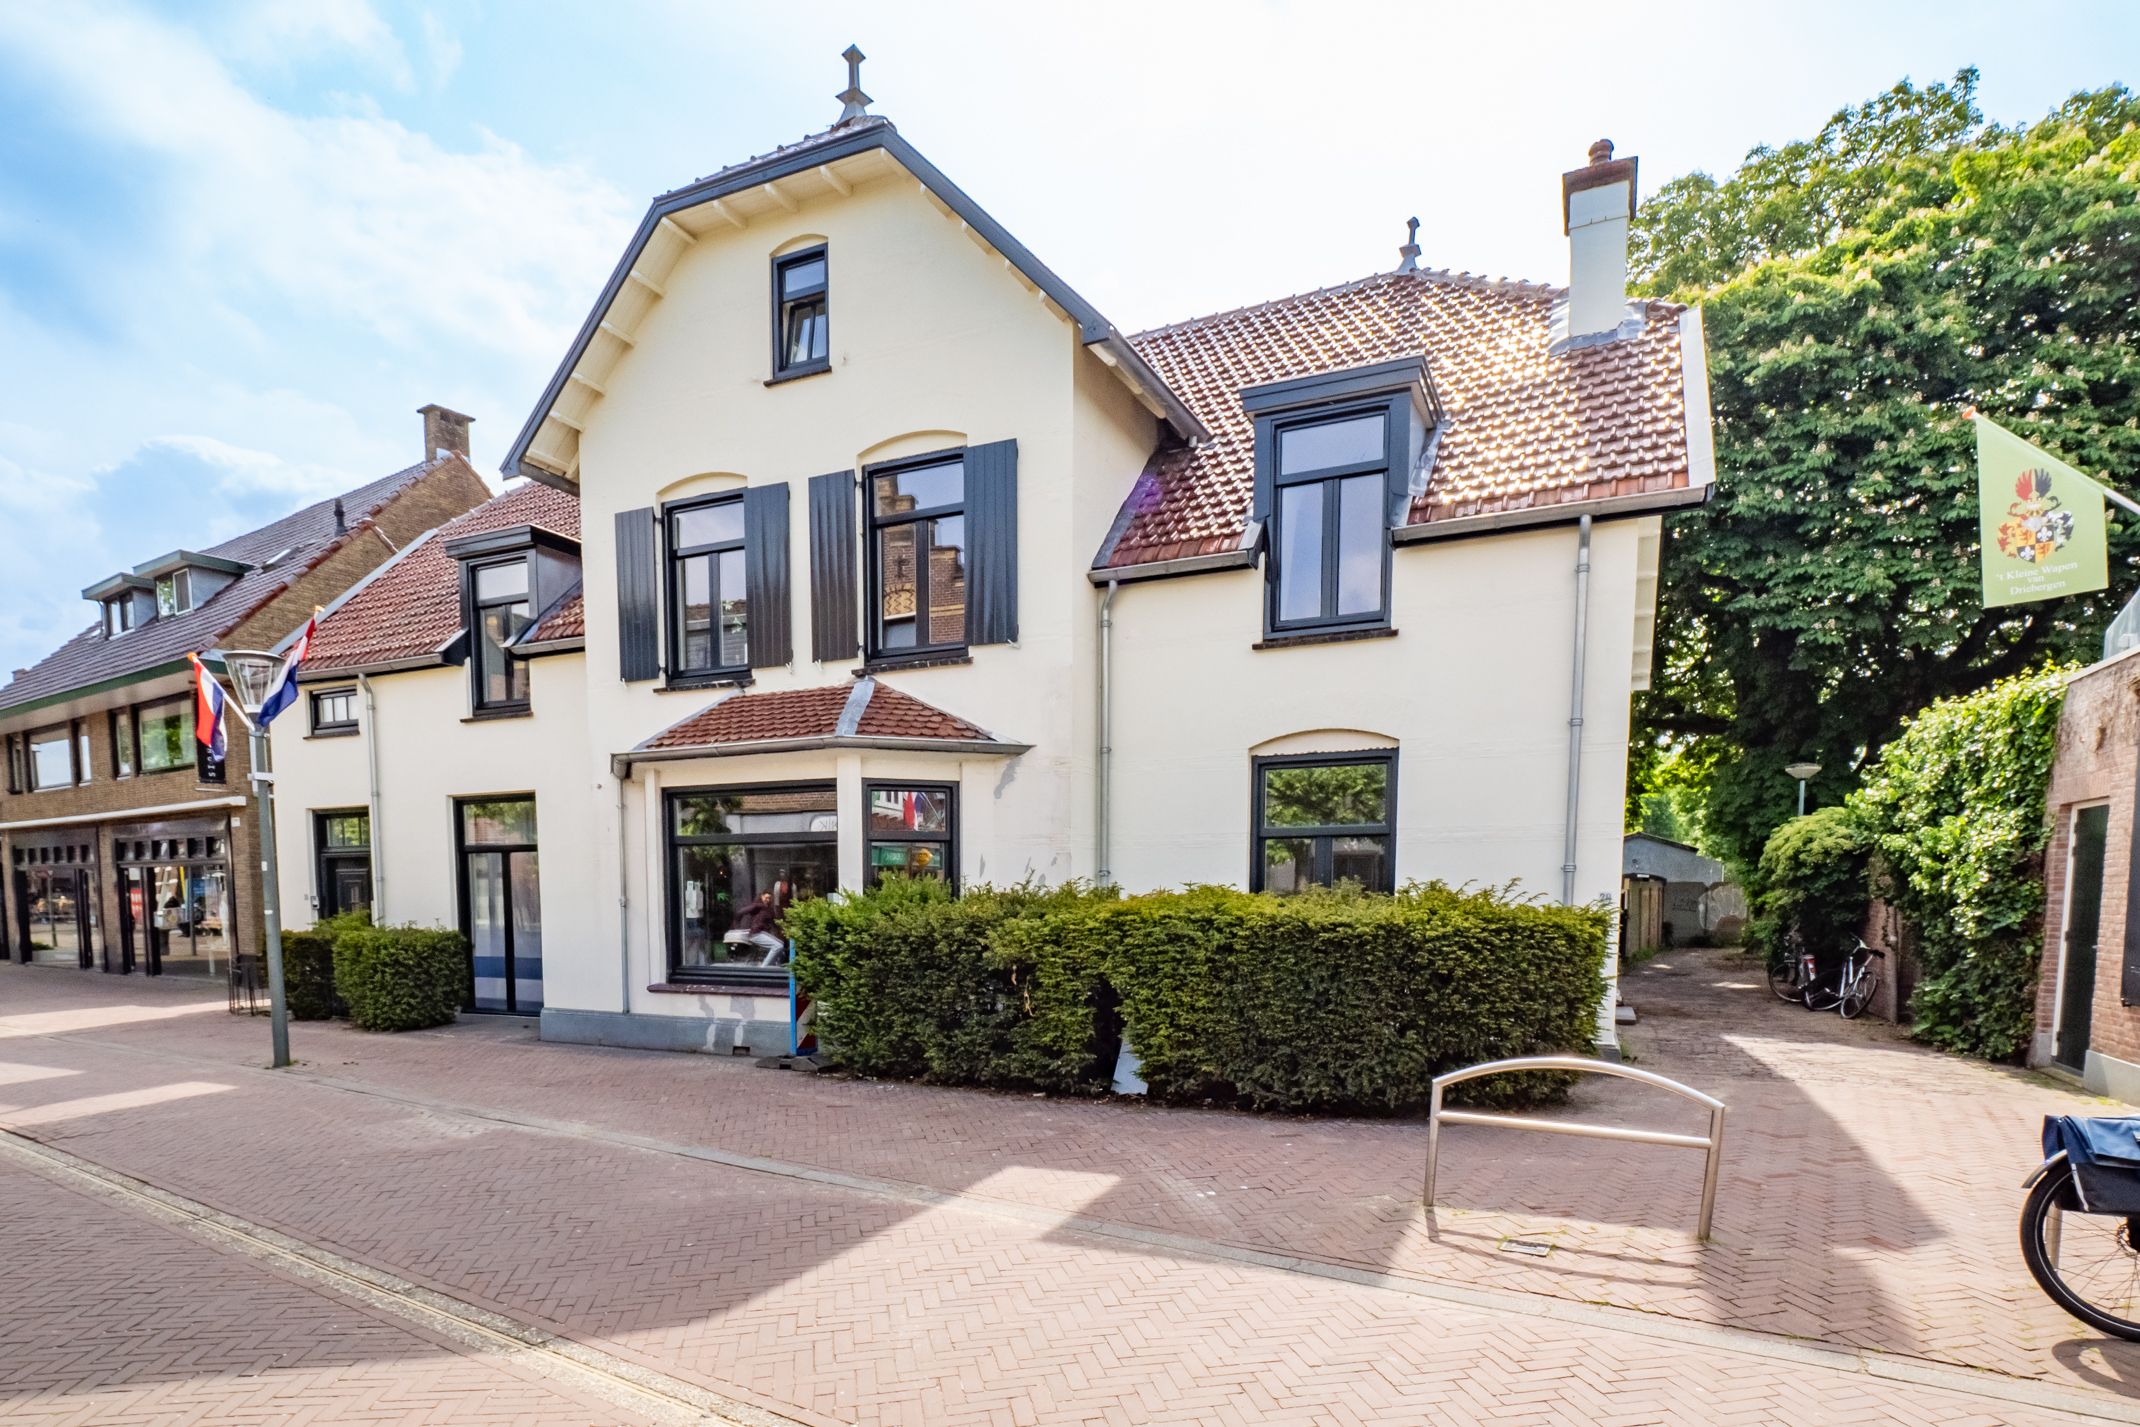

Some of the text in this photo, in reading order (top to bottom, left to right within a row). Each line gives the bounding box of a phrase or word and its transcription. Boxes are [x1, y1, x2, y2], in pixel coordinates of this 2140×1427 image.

[2006, 569, 2039, 580] Kleine
[2041, 562, 2078, 574] Wapen
[2027, 575, 2045, 583] van
[2009, 581, 2066, 596] Driebergen
